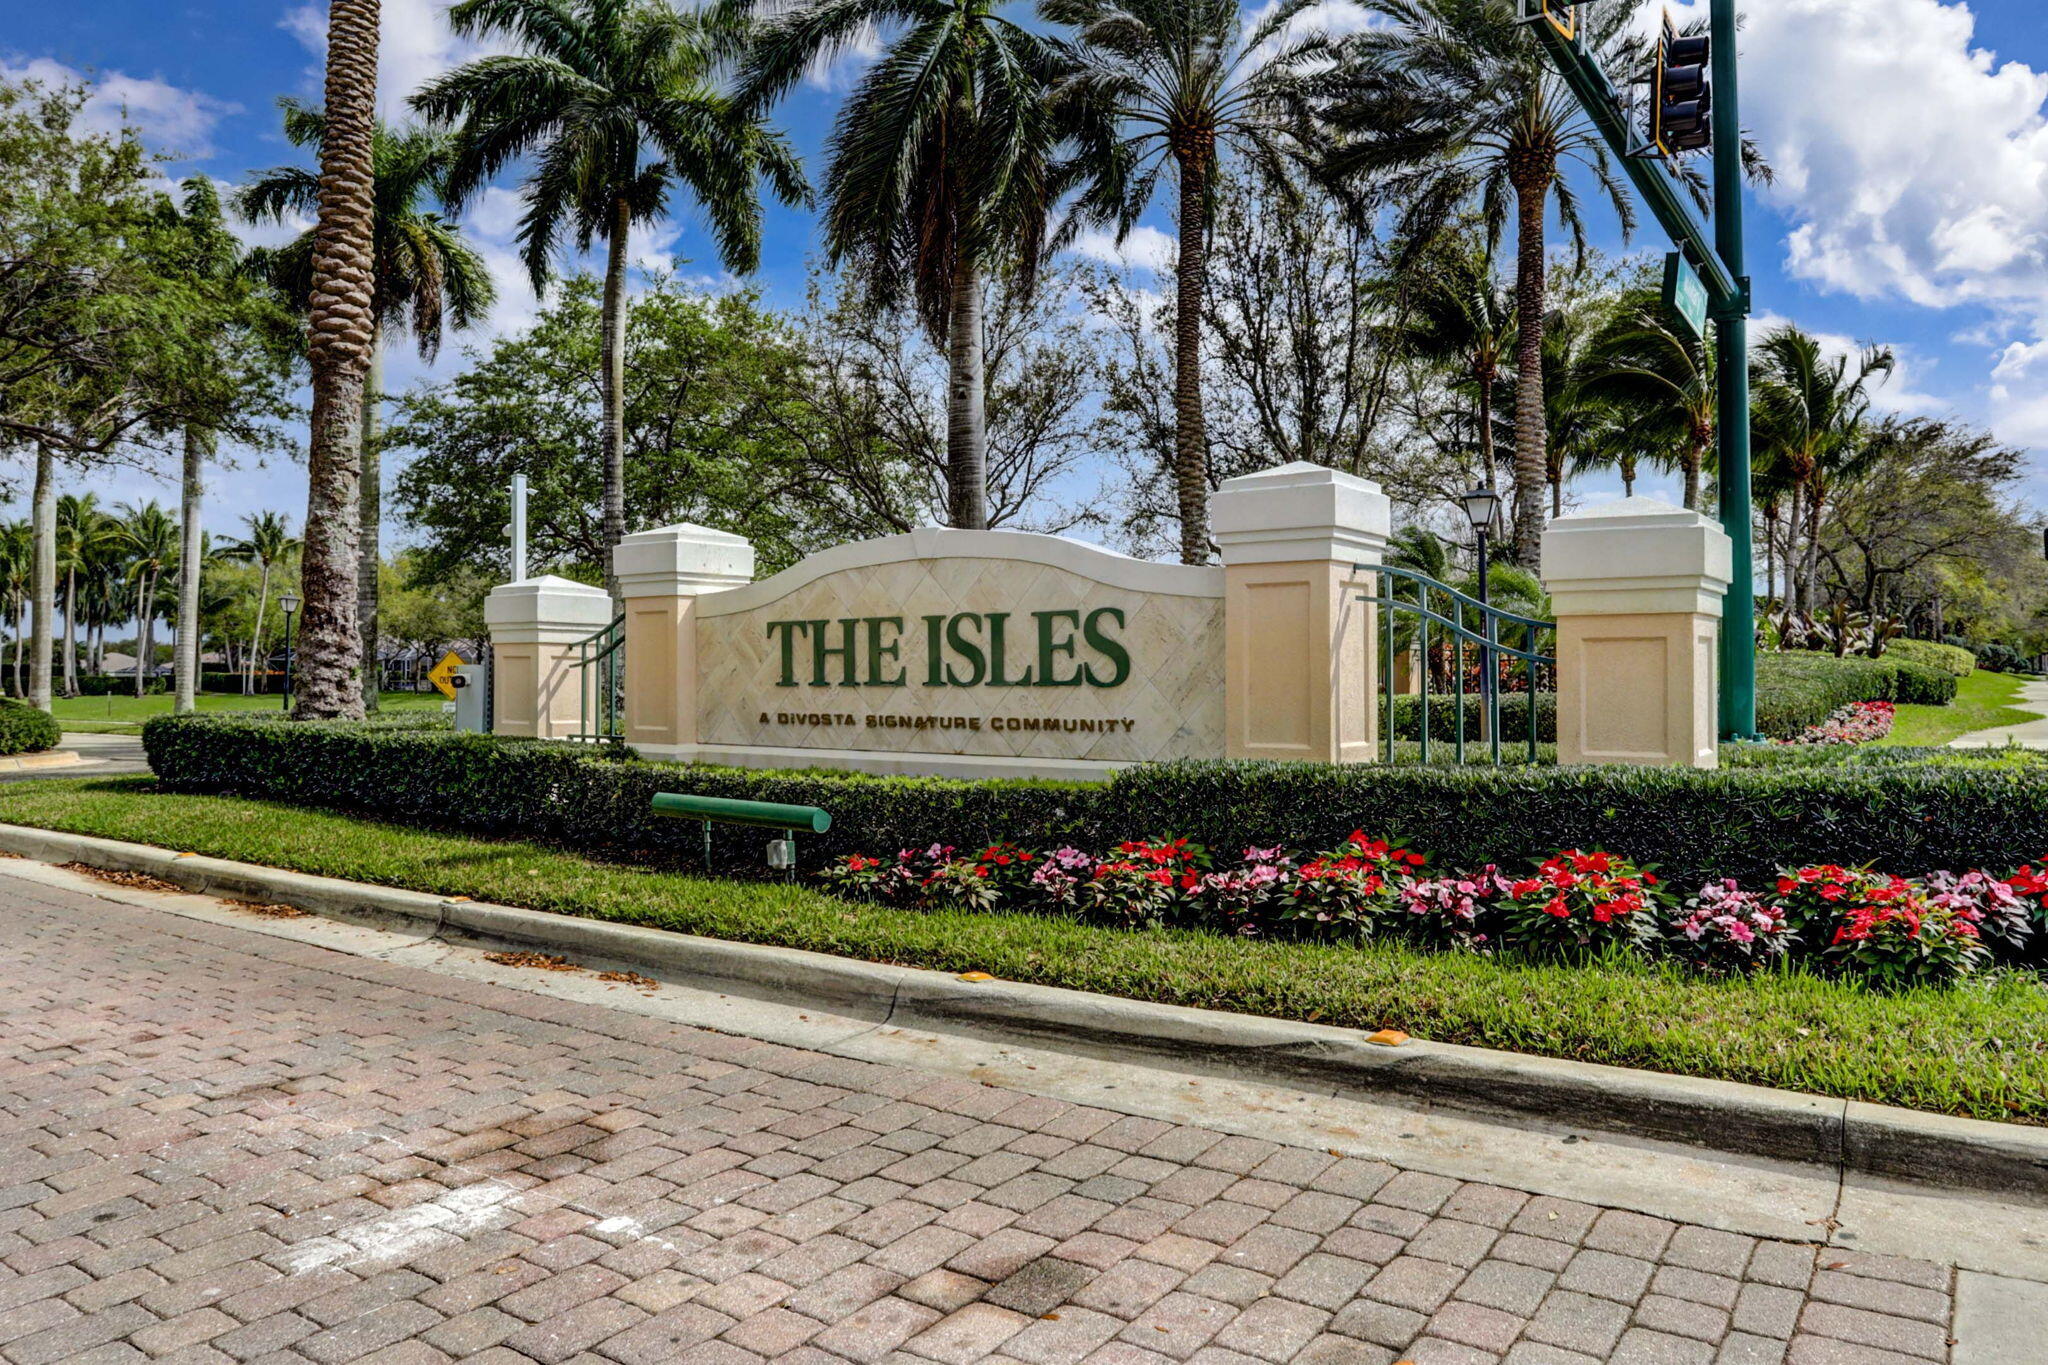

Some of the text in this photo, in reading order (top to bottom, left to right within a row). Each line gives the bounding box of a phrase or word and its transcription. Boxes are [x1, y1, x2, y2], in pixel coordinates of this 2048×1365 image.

[766, 606, 1132, 689] THE ISLES
[758, 712, 770, 725] A
[865, 714, 982, 731] SIGNATURE
[990, 716, 1136, 733] COMMUNITY
